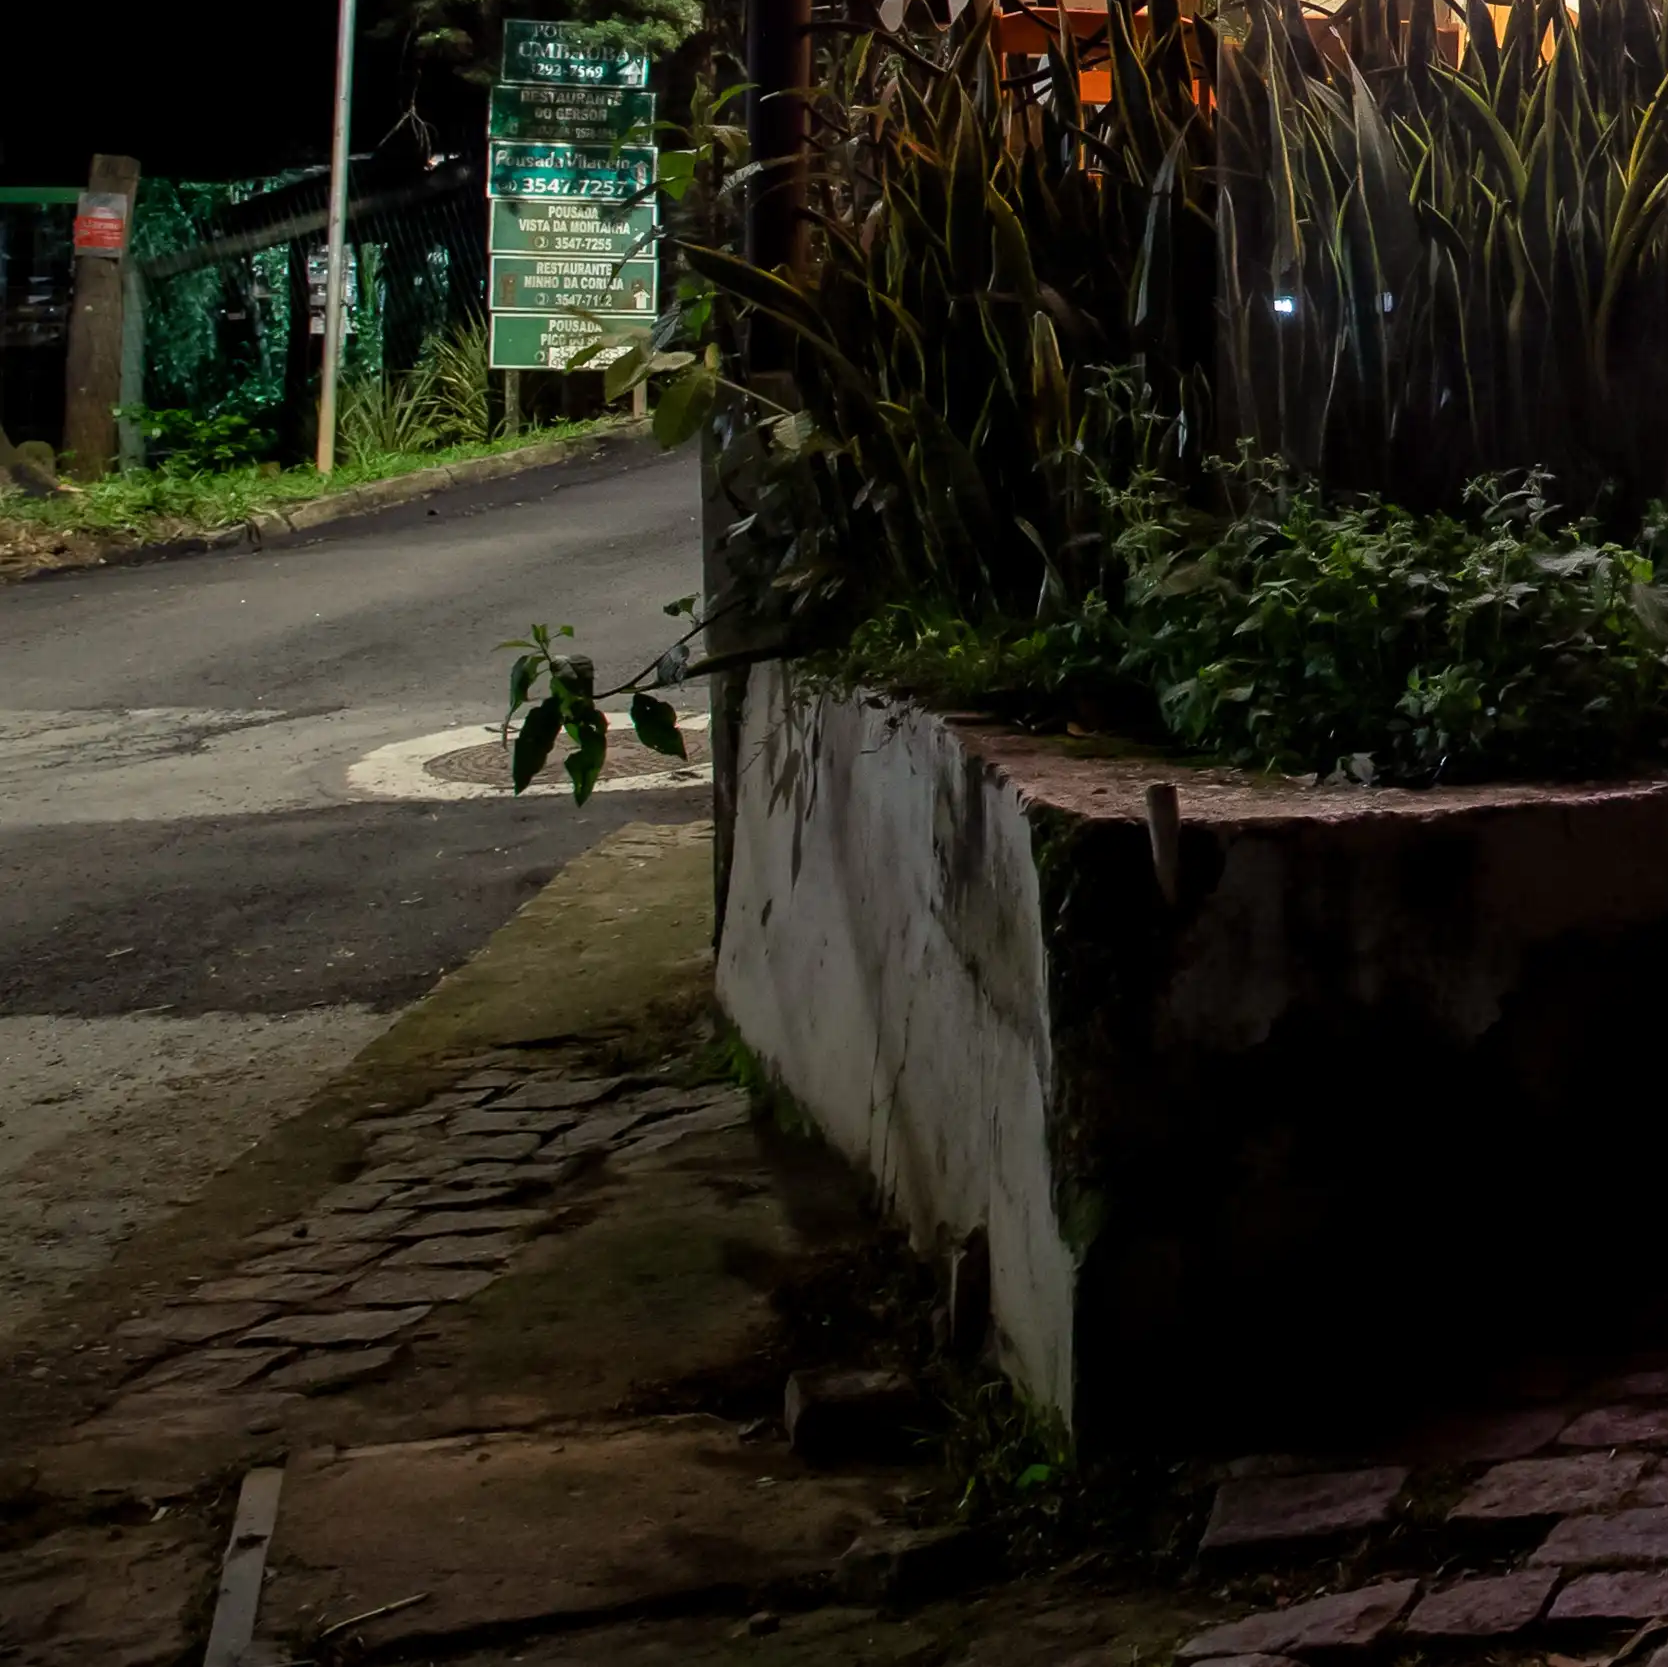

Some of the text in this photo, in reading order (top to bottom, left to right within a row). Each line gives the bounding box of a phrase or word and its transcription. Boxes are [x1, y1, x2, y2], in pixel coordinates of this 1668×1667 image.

[520, 89, 624, 106] RESTAURANTE
[495, 149, 564, 169] Pousada
[548, 205, 599, 219] POUSADA
[518, 219, 550, 232] VISTA
[553, 220, 567, 233] DA
[555, 237, 613, 251] 3547-7255
[536, 262, 613, 276] RESTAURANTE
[563, 276, 579, 289] DA
[555, 294, 613, 308] 3547-712
[548, 319, 603, 333] POUSADA
